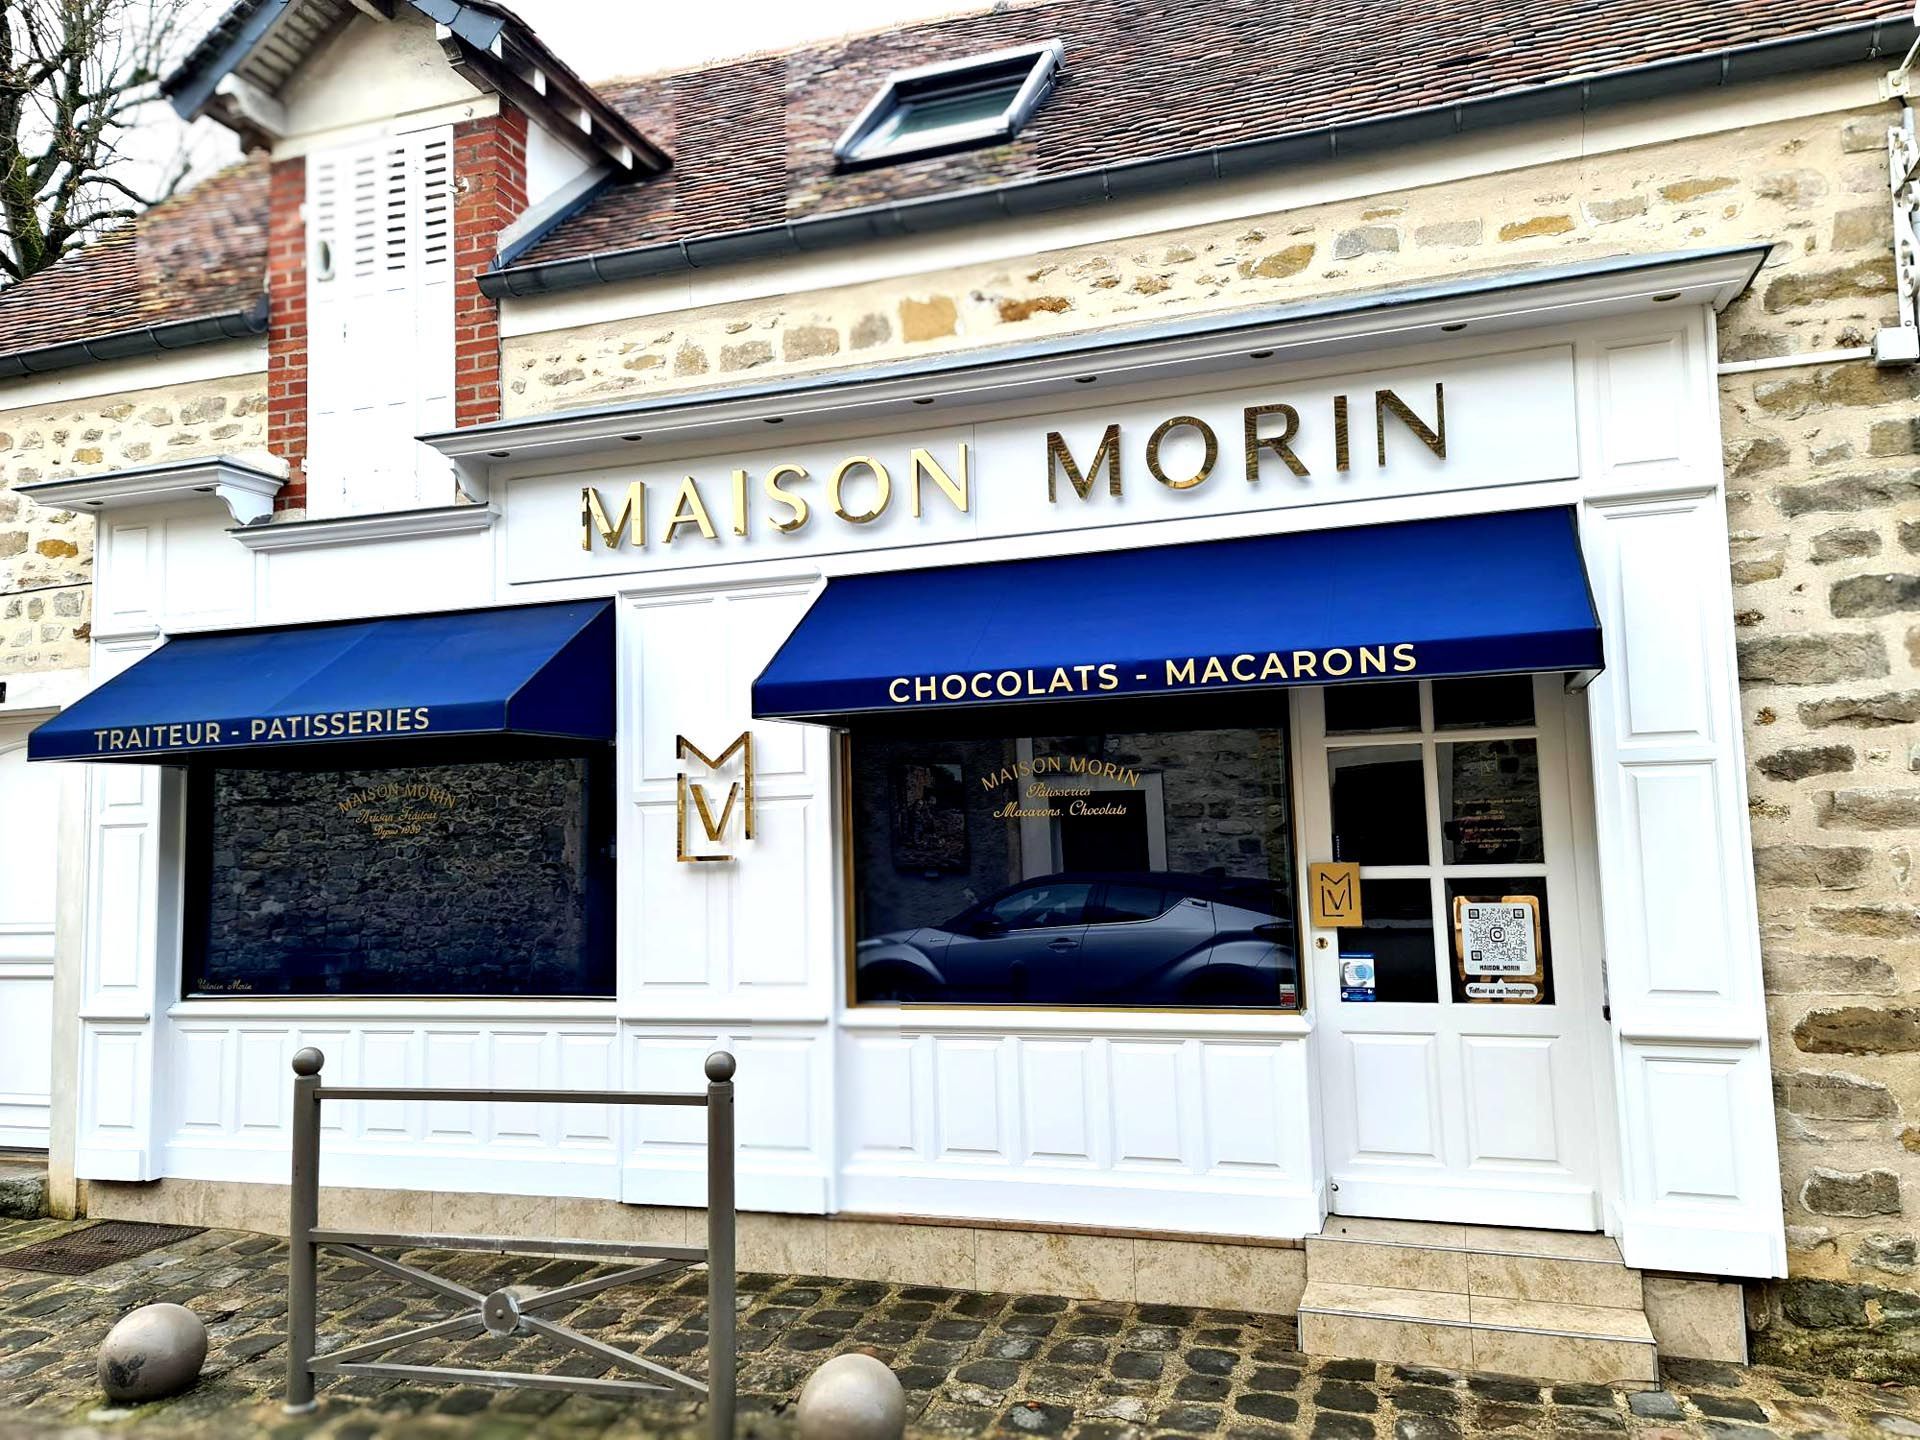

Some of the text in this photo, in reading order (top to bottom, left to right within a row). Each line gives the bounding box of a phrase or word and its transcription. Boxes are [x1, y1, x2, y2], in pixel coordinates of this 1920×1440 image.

[582, 382, 1447, 552] MAISON MORIN
[889, 663, 1119, 704] CHOCOLATS
[1165, 643, 1417, 686] MACARONS
[94, 722, 221, 751] TRAITEUR
[251, 707, 430, 741] PATISSERIES
[981, 756, 1140, 792] MAISON MORIN
[336, 783, 457, 813] MAISON MORIN
[1069, 800, 1127, 816] Chocolats
[1468, 986, 1488, 995] Follow
[1505, 987, 1535, 997] Instagram
